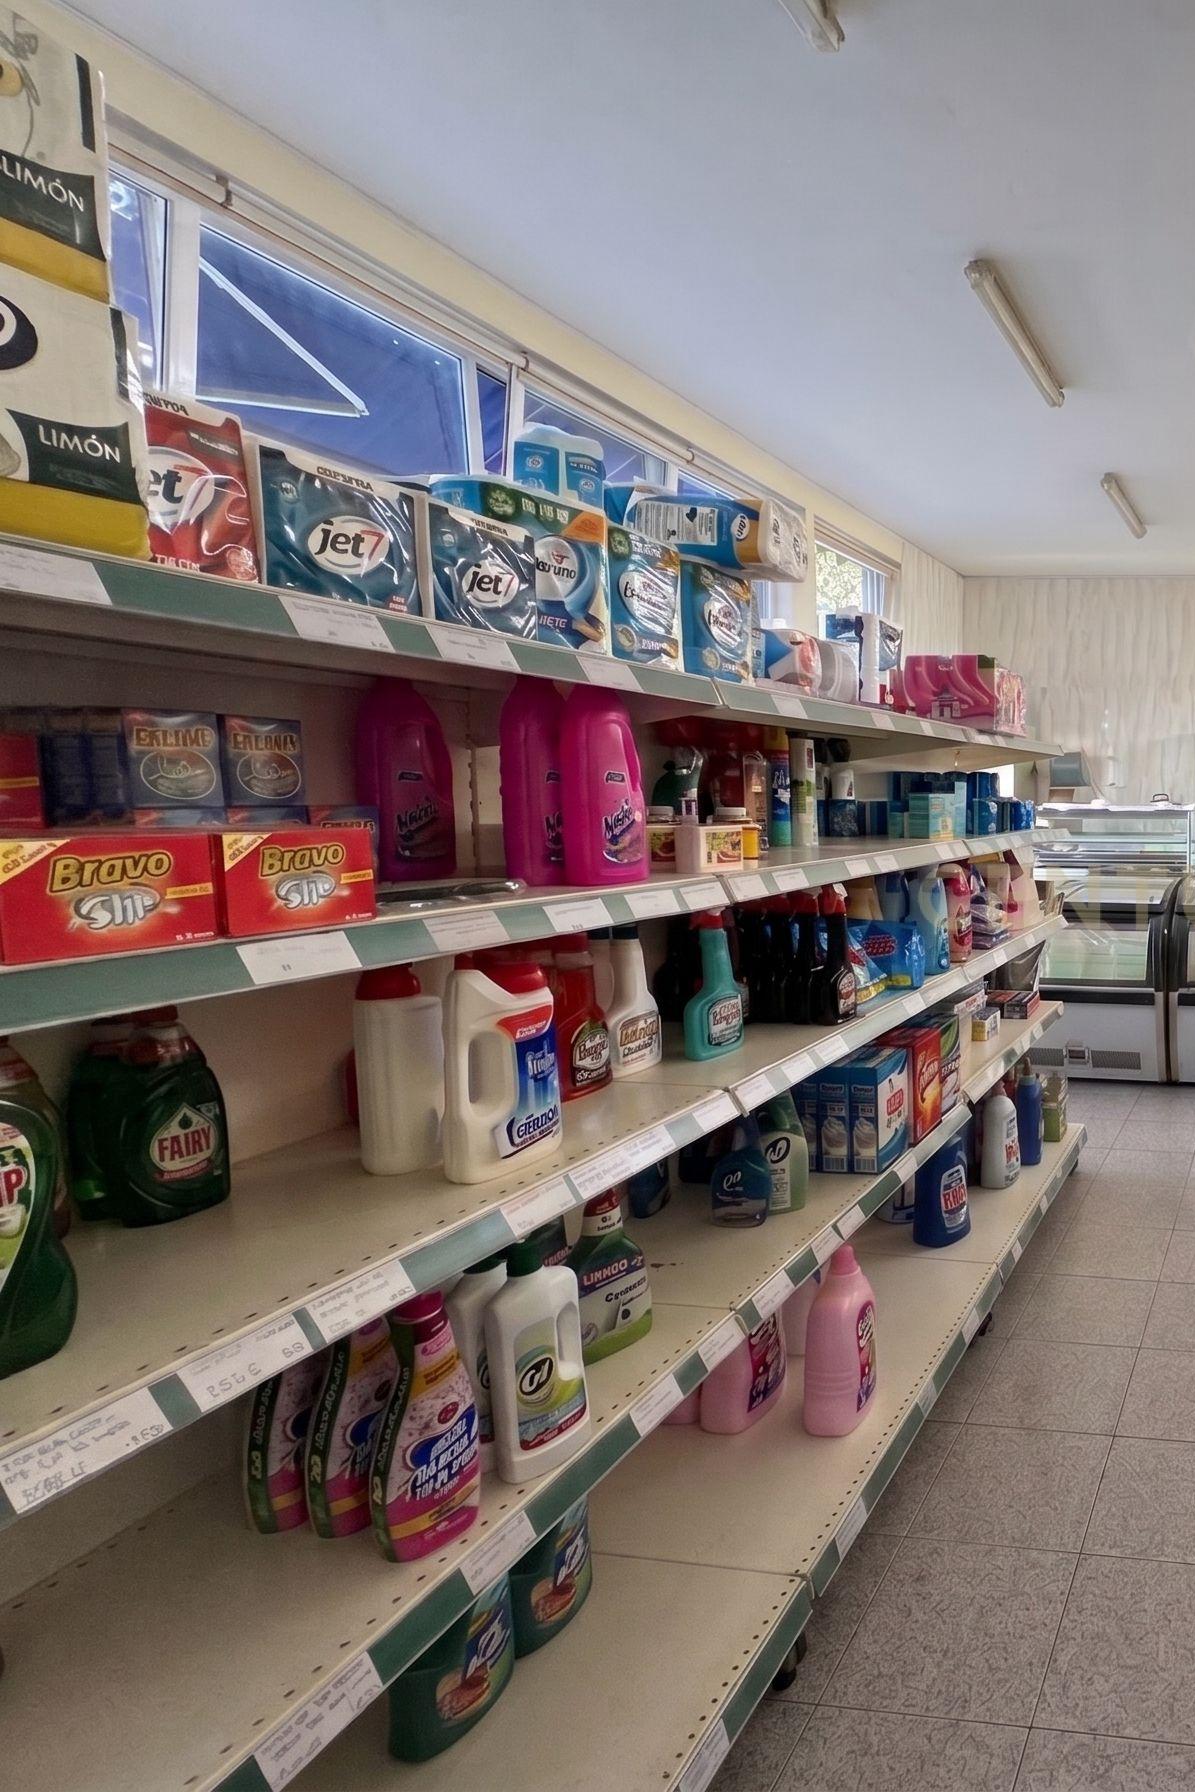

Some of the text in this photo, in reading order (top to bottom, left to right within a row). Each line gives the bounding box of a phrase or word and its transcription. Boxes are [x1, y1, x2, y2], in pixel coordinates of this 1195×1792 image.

[1, 155, 86, 213] LIMÓN
[38, 424, 121, 464] LIMÓN
[49, 852, 172, 893] Bravo
[259, 845, 346, 877] Bravo
[156, 1126, 212, 1163] FAIRY
